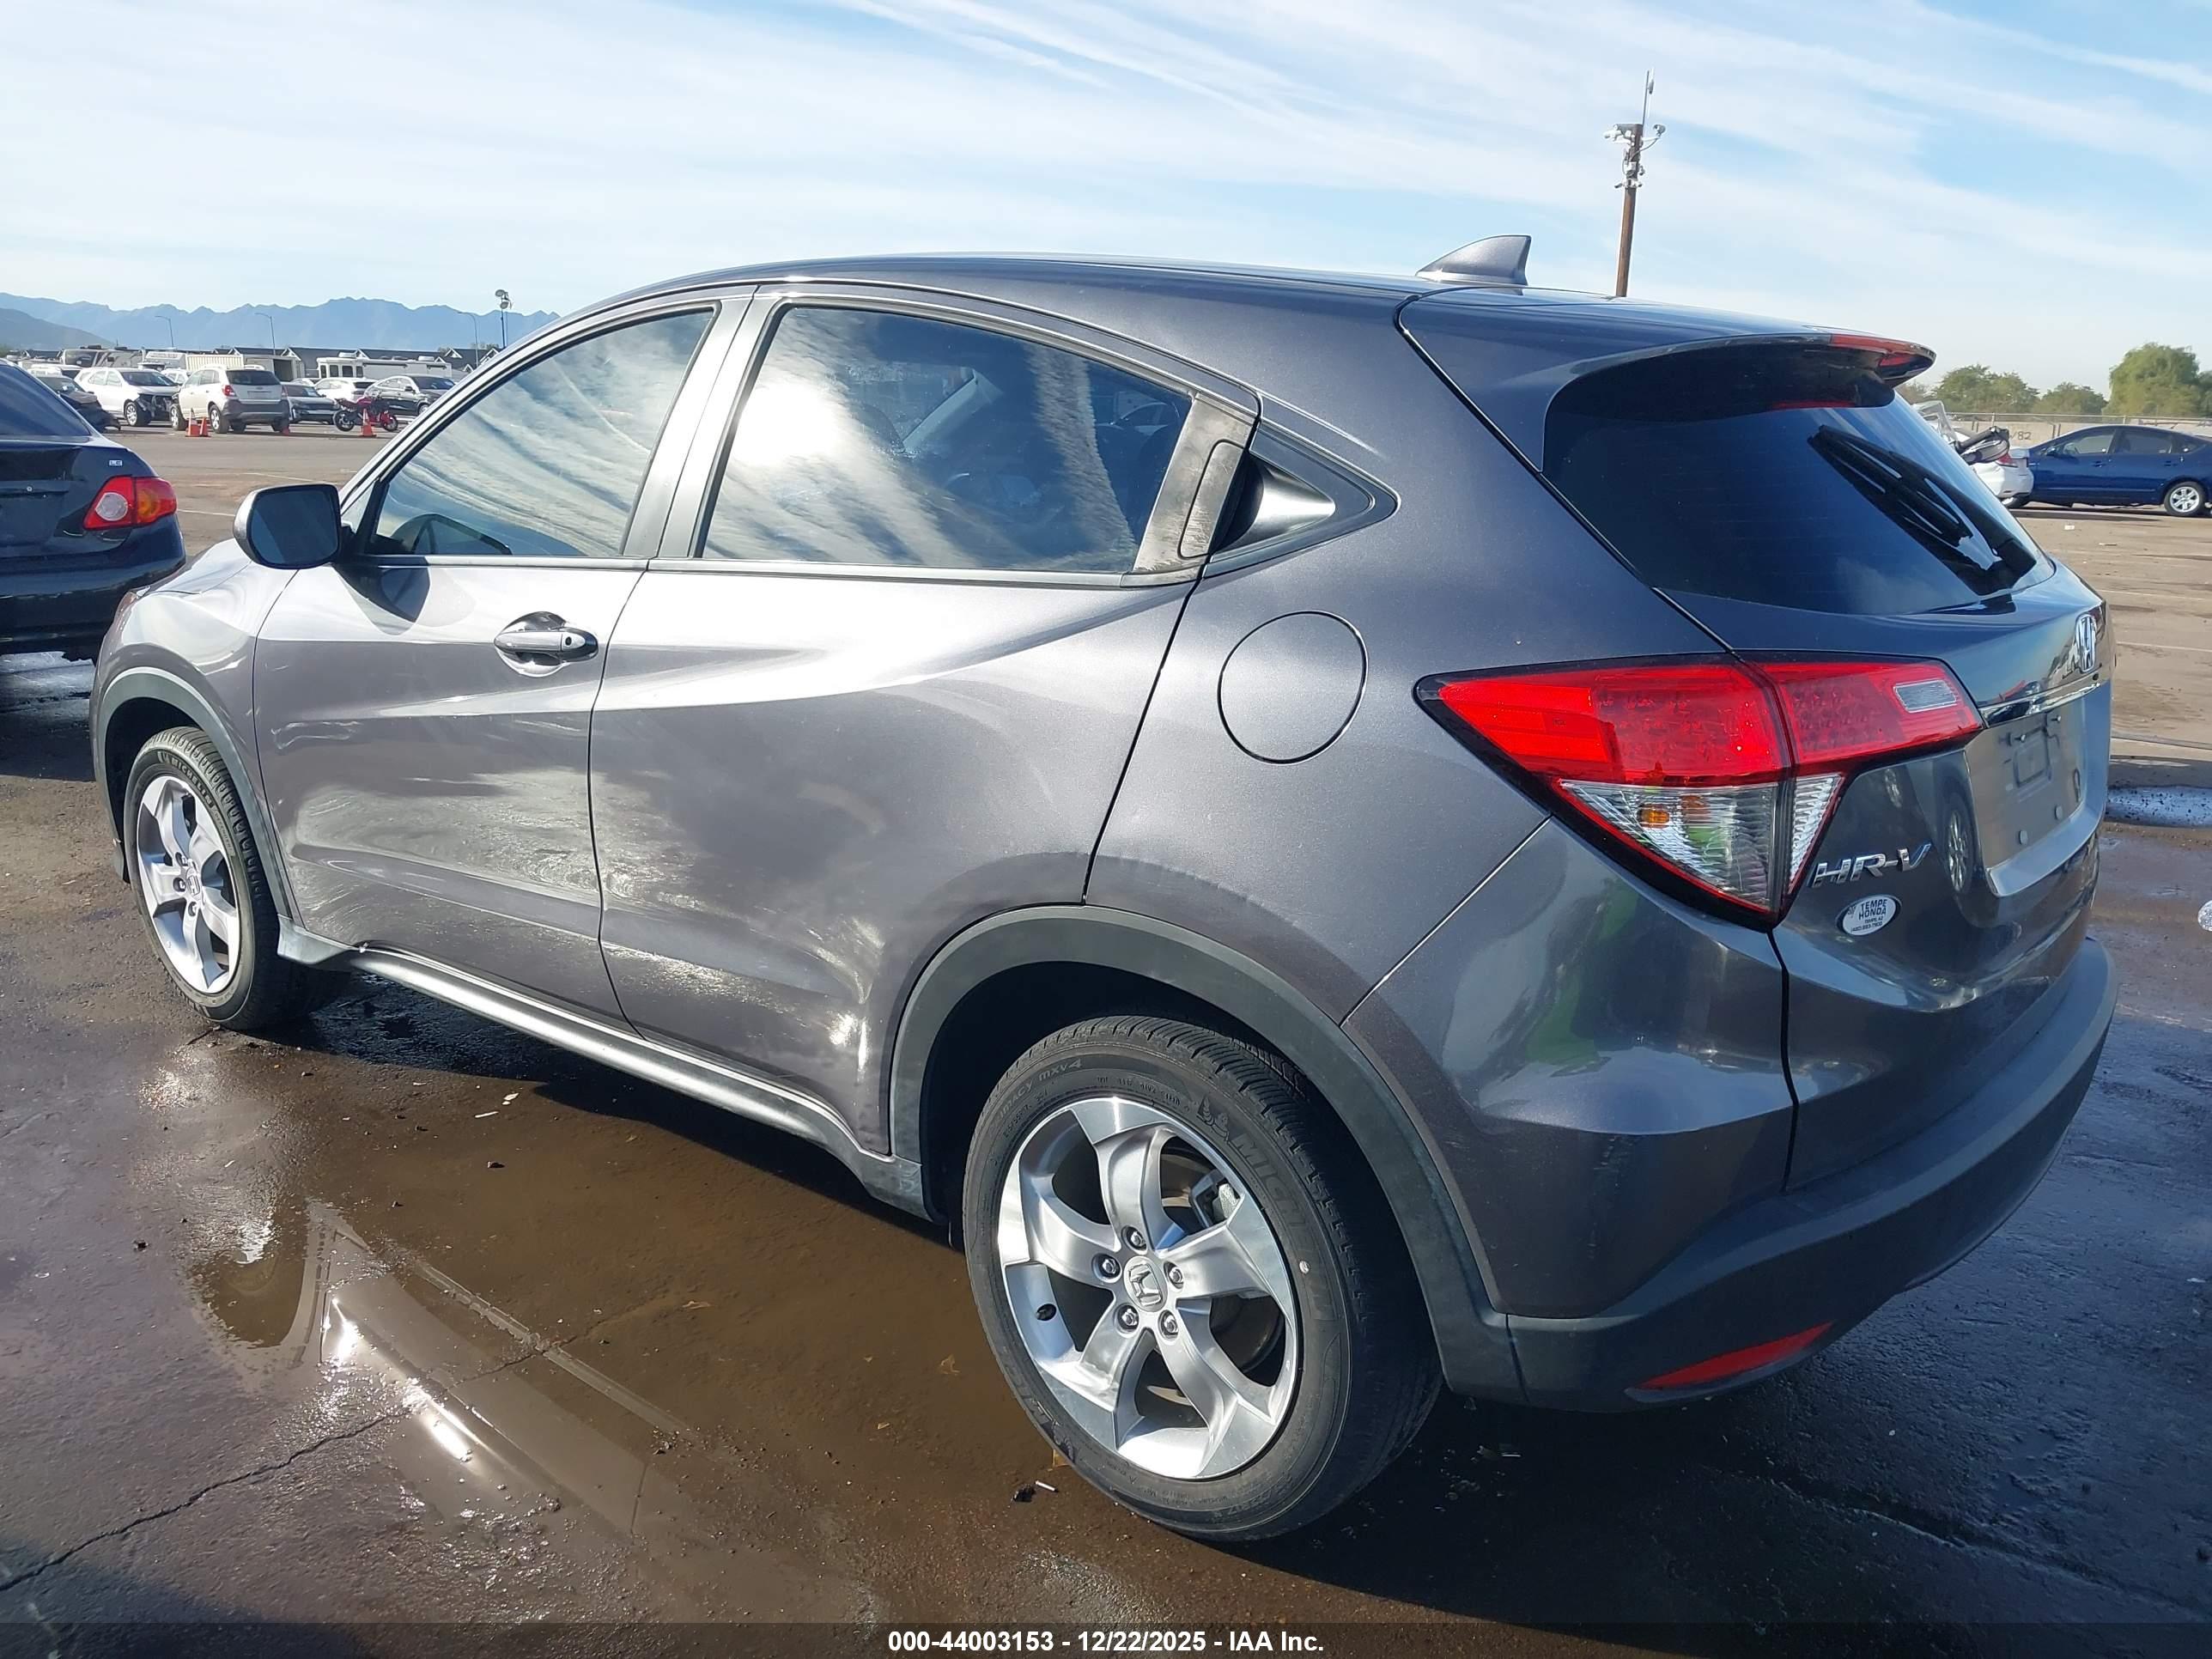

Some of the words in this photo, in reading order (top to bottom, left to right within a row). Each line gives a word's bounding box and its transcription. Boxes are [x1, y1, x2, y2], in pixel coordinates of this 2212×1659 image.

[1807, 842, 1932, 888] HR-V
[1861, 898, 1887, 911] TEMPE
[1858, 907, 1887, 921] HONDA
